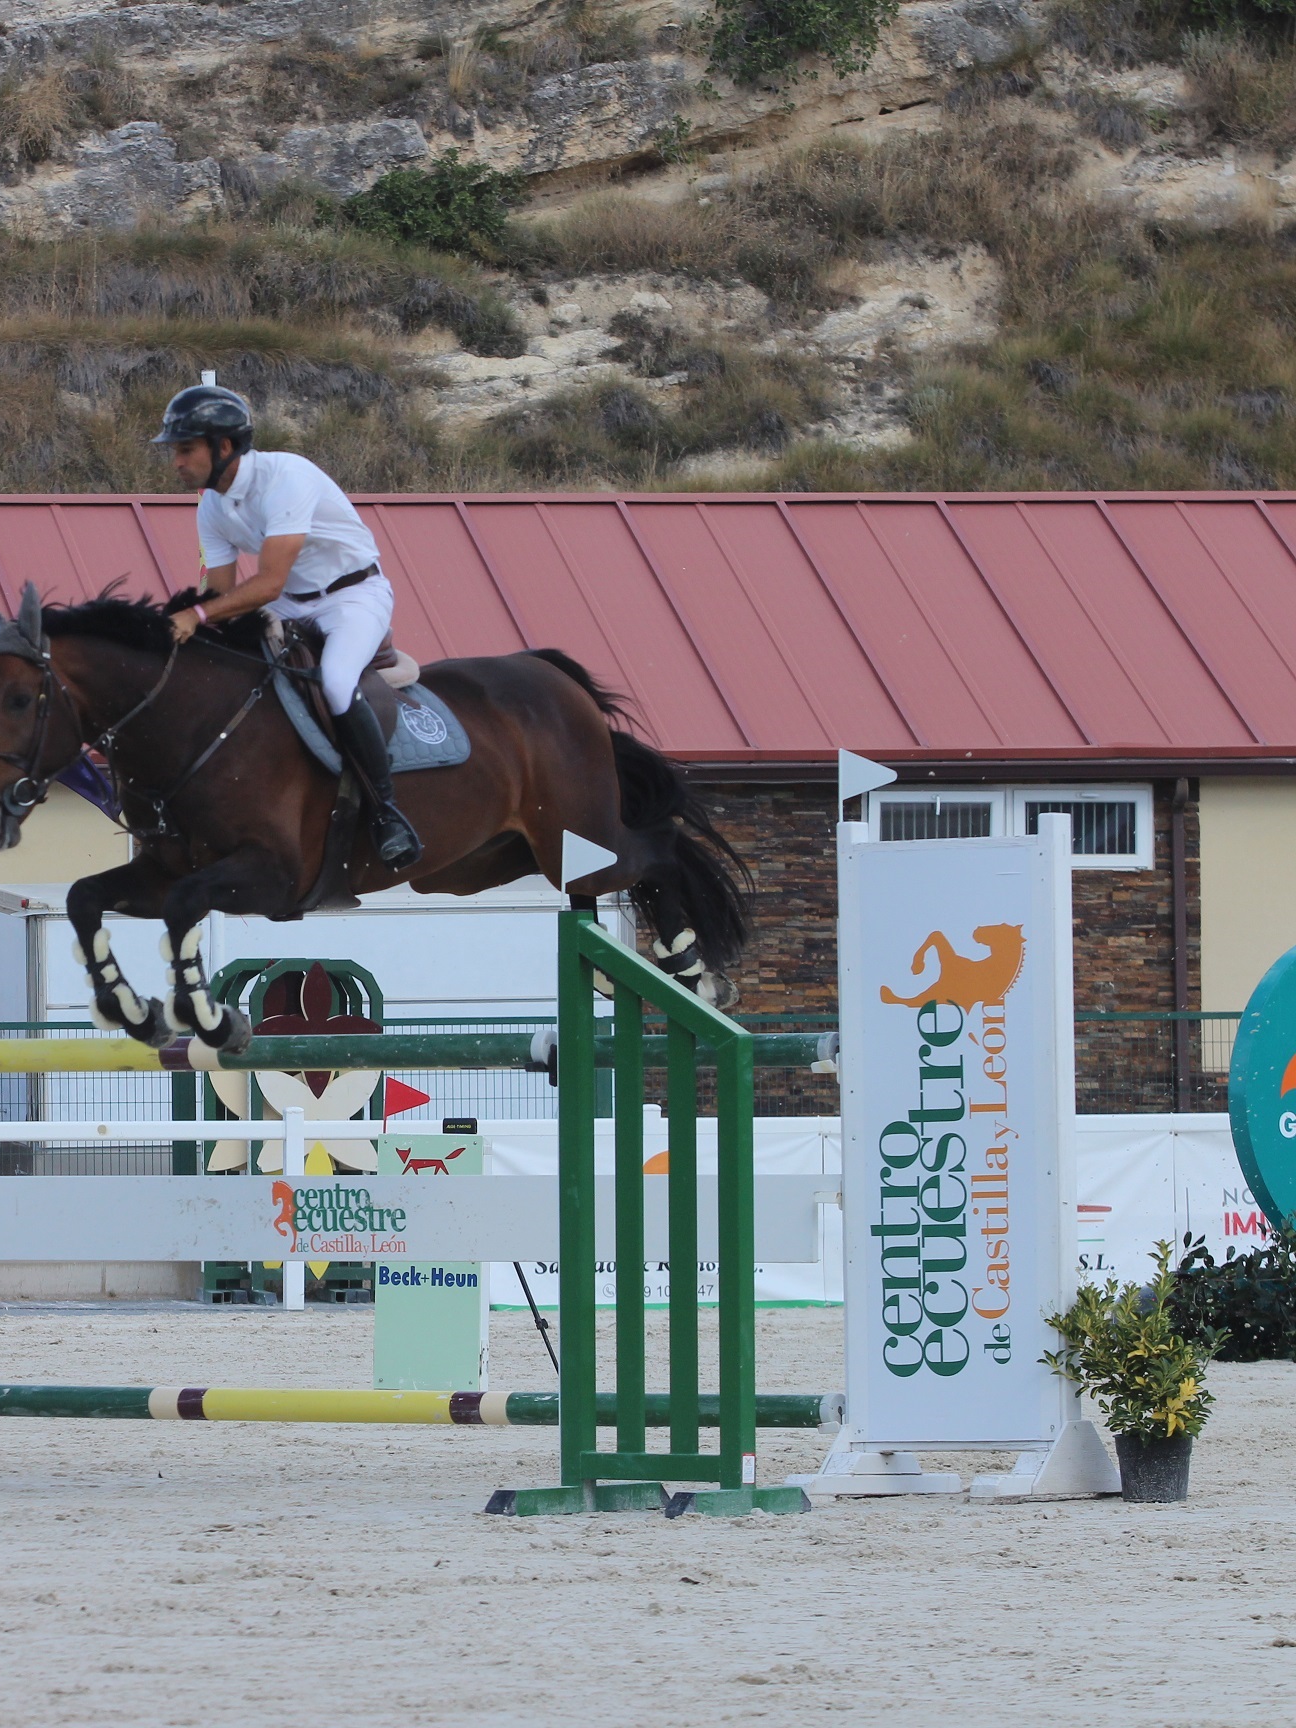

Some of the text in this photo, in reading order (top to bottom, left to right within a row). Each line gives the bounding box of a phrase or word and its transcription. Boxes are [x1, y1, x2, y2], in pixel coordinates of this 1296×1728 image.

[293, 1183, 371, 1210] centro
[908, 999, 969, 1377] ecuestre
[968, 1000, 1019, 1364] de Castilla y León
[293, 1202, 406, 1233] ecuestre
[296, 1238, 309, 1253] de
[310, 1234, 363, 1253] Castilla
[370, 1234, 407, 1253] León
[870, 1121, 923, 1378] centro
[378, 1265, 478, 1288] Beck+Heun
[1078, 1253, 1115, 1271] S.L.
